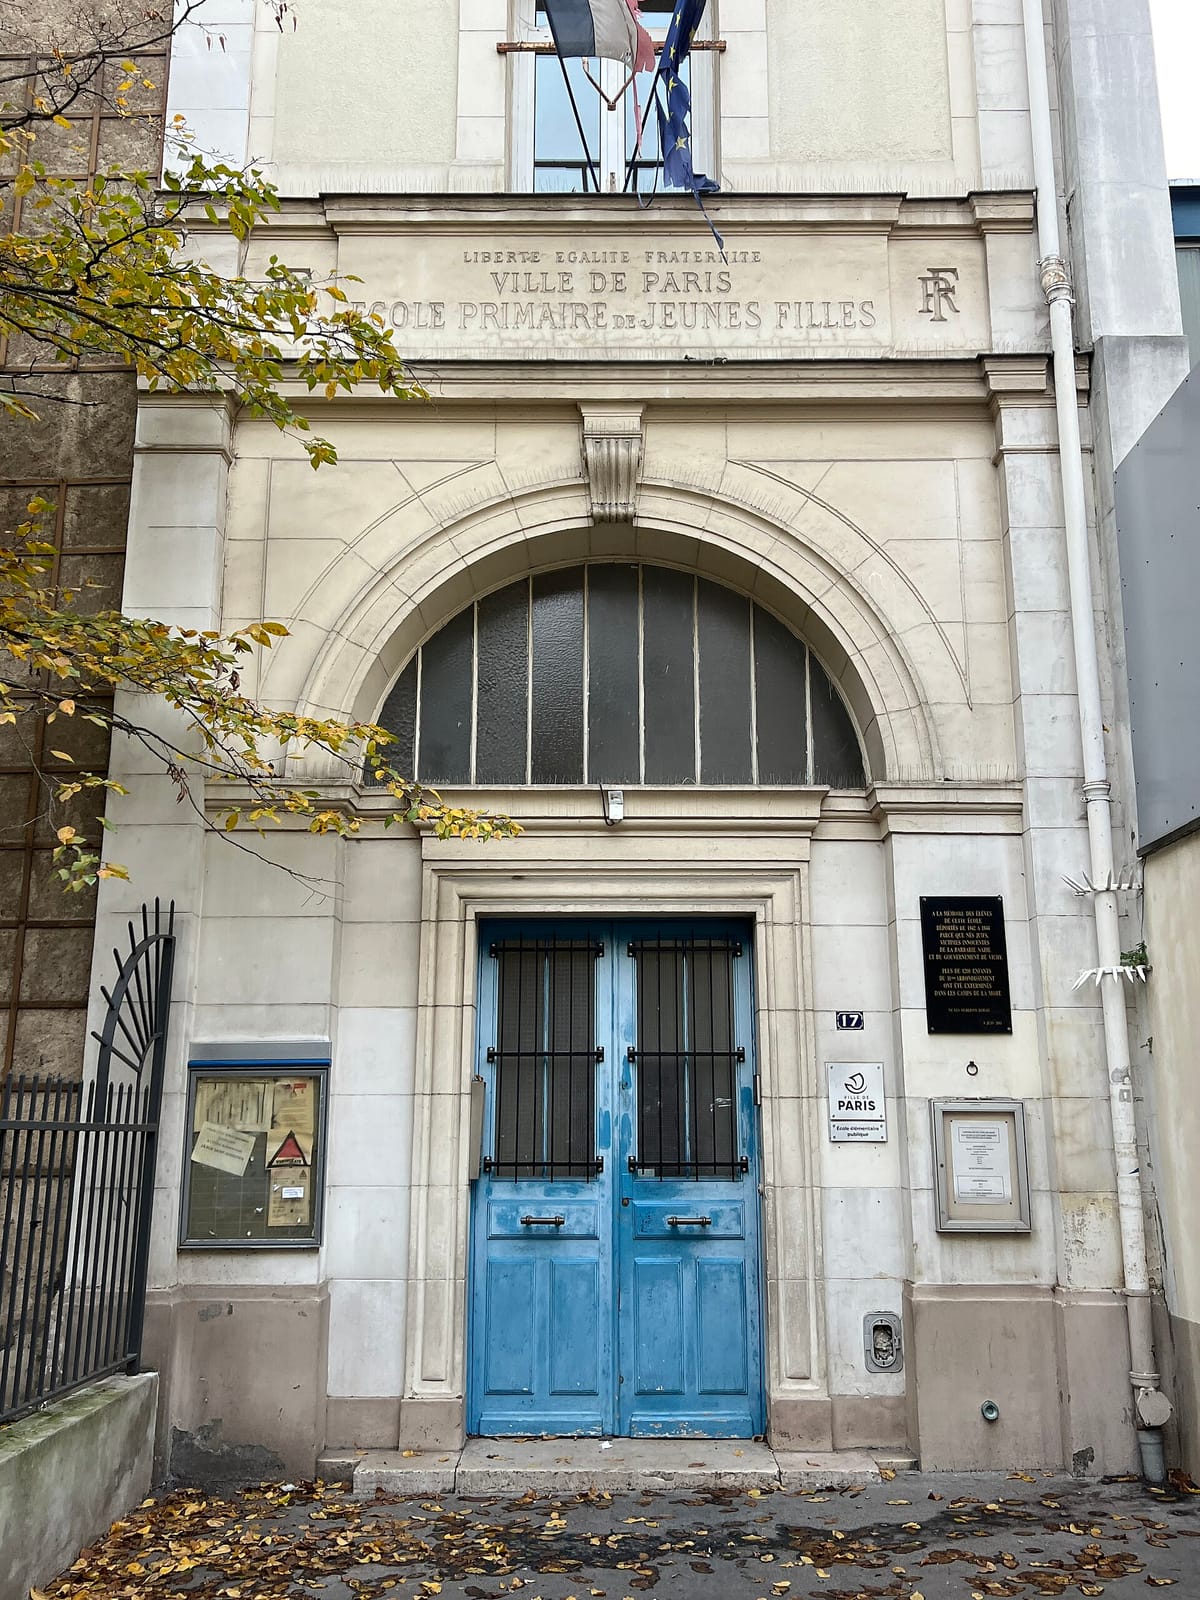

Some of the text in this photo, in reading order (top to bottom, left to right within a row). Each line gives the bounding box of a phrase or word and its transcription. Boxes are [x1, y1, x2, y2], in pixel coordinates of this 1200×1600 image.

[463, 250, 761, 264] LIBERTE EGALITE FRATERNITE
[490, 271, 732, 294] VILLE DE PARIS
[457, 301, 607, 330] PRIMAIRE
[612, 314, 637, 329] DE
[640, 301, 762, 330] JEUNES
[775, 301, 876, 330] FILLES
[841, 1014, 859, 1027] 17
[838, 1100, 876, 1111] PARIS
